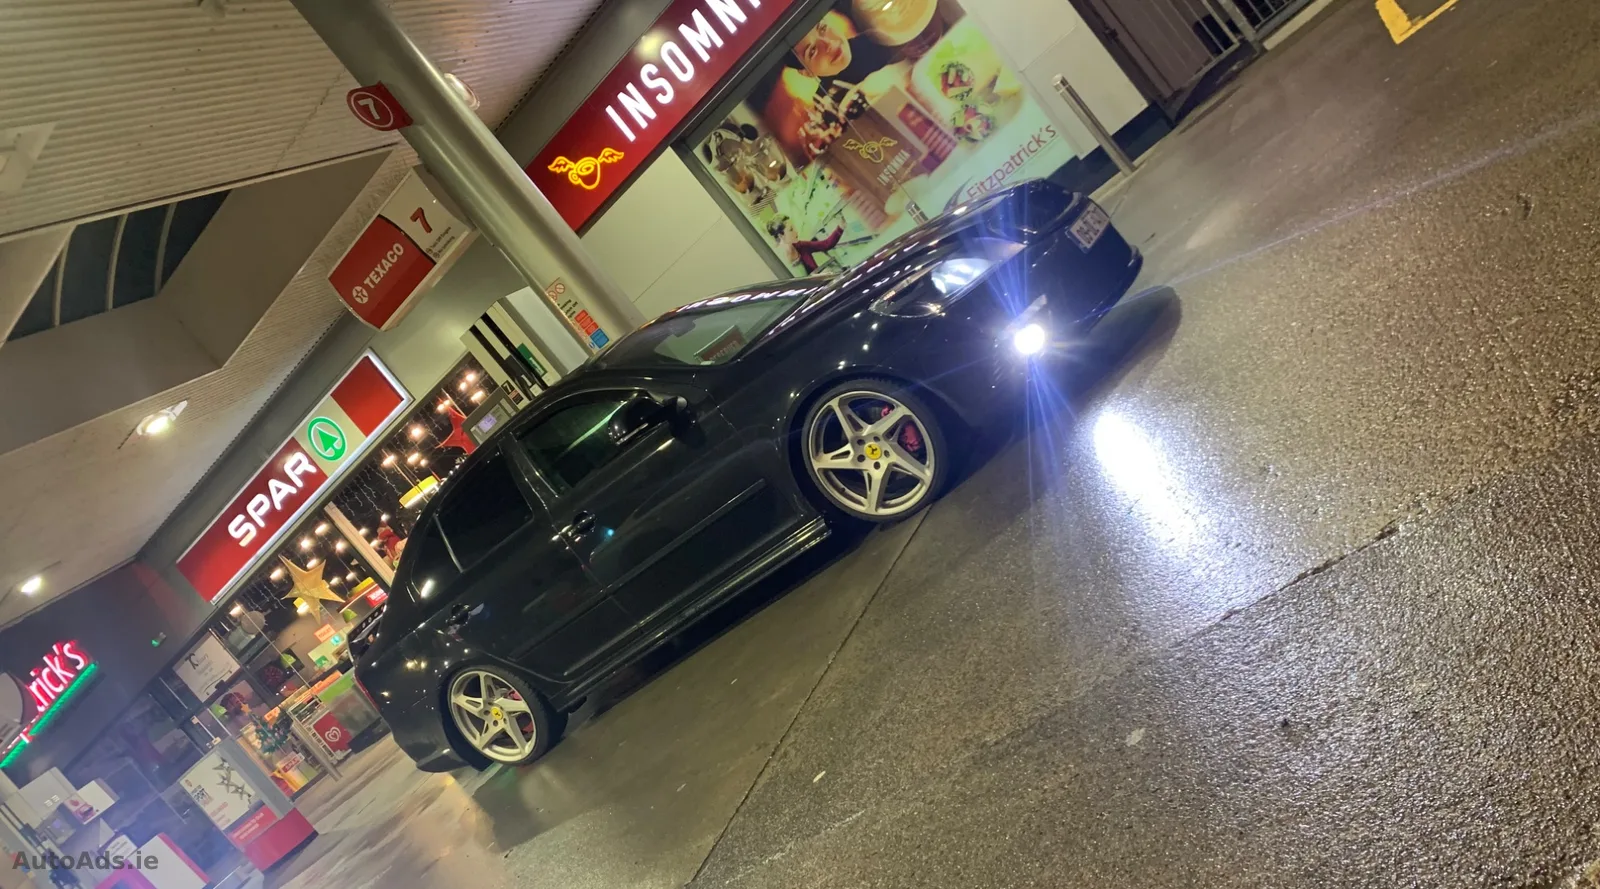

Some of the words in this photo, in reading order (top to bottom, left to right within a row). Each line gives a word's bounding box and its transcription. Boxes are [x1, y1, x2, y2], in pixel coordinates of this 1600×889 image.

[606, 0, 761, 142] INSOMN
[358, 98, 380, 119] 7
[877, 149, 910, 186] INSOMNIA
[966, 125, 1056, 198] Fitzpatrick's
[410, 207, 433, 233] 7
[363, 243, 404, 289] TEXACO
[503, 383, 512, 393] 7
[227, 451, 317, 547] SPAR
[29, 641, 88, 712] rick's
